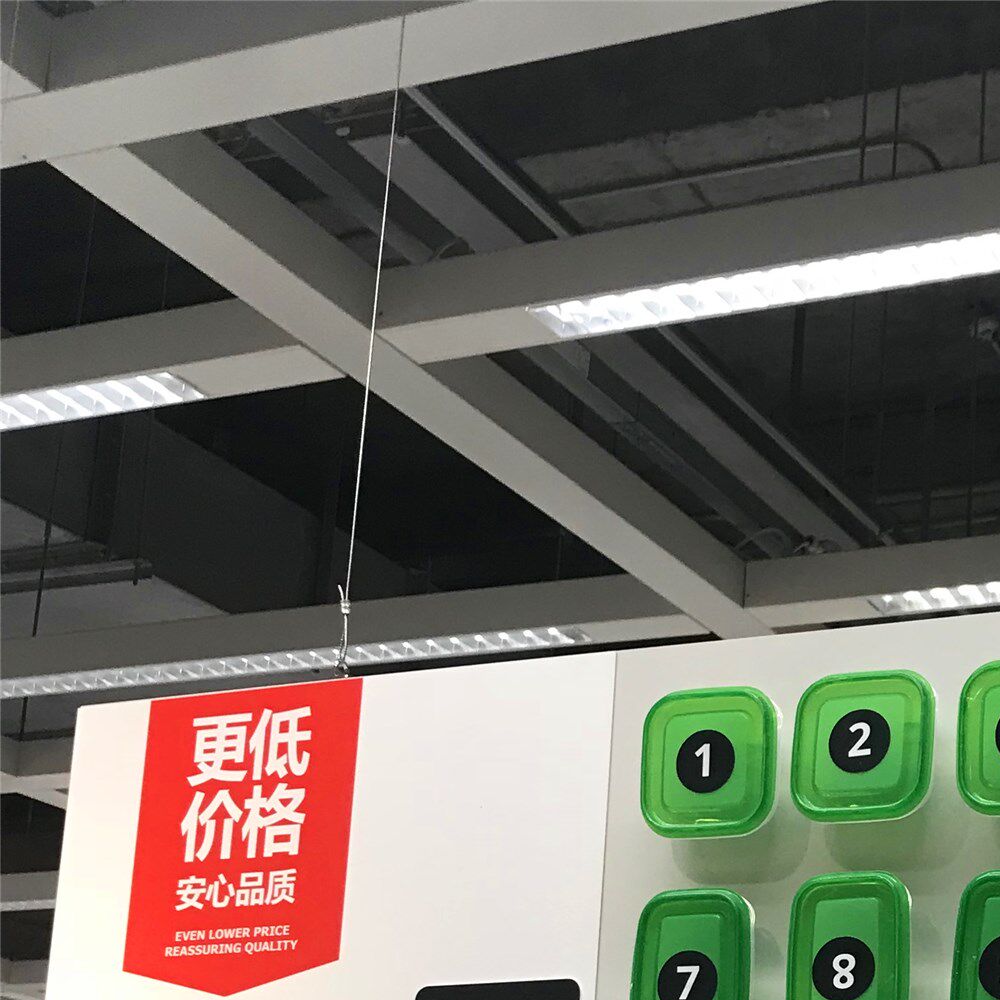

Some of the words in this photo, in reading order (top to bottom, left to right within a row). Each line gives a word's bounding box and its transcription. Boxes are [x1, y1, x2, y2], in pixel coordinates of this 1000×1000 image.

[187, 706, 312, 787] 更低
[847, 721, 872, 758] 2
[694, 743, 711, 778] 1
[181, 783, 306, 863] 价格
[175, 869, 297, 911] 安心品质
[164, 943, 242, 957] REASSURING
[244, 939, 298, 955] QUALITY
[175, 930, 206, 942] EVEN
[208, 927, 251, 940] LOWER
[253, 925, 290, 938] PRICE
[676, 965, 700, 1000] 7
[832, 953, 856, 990] 8
